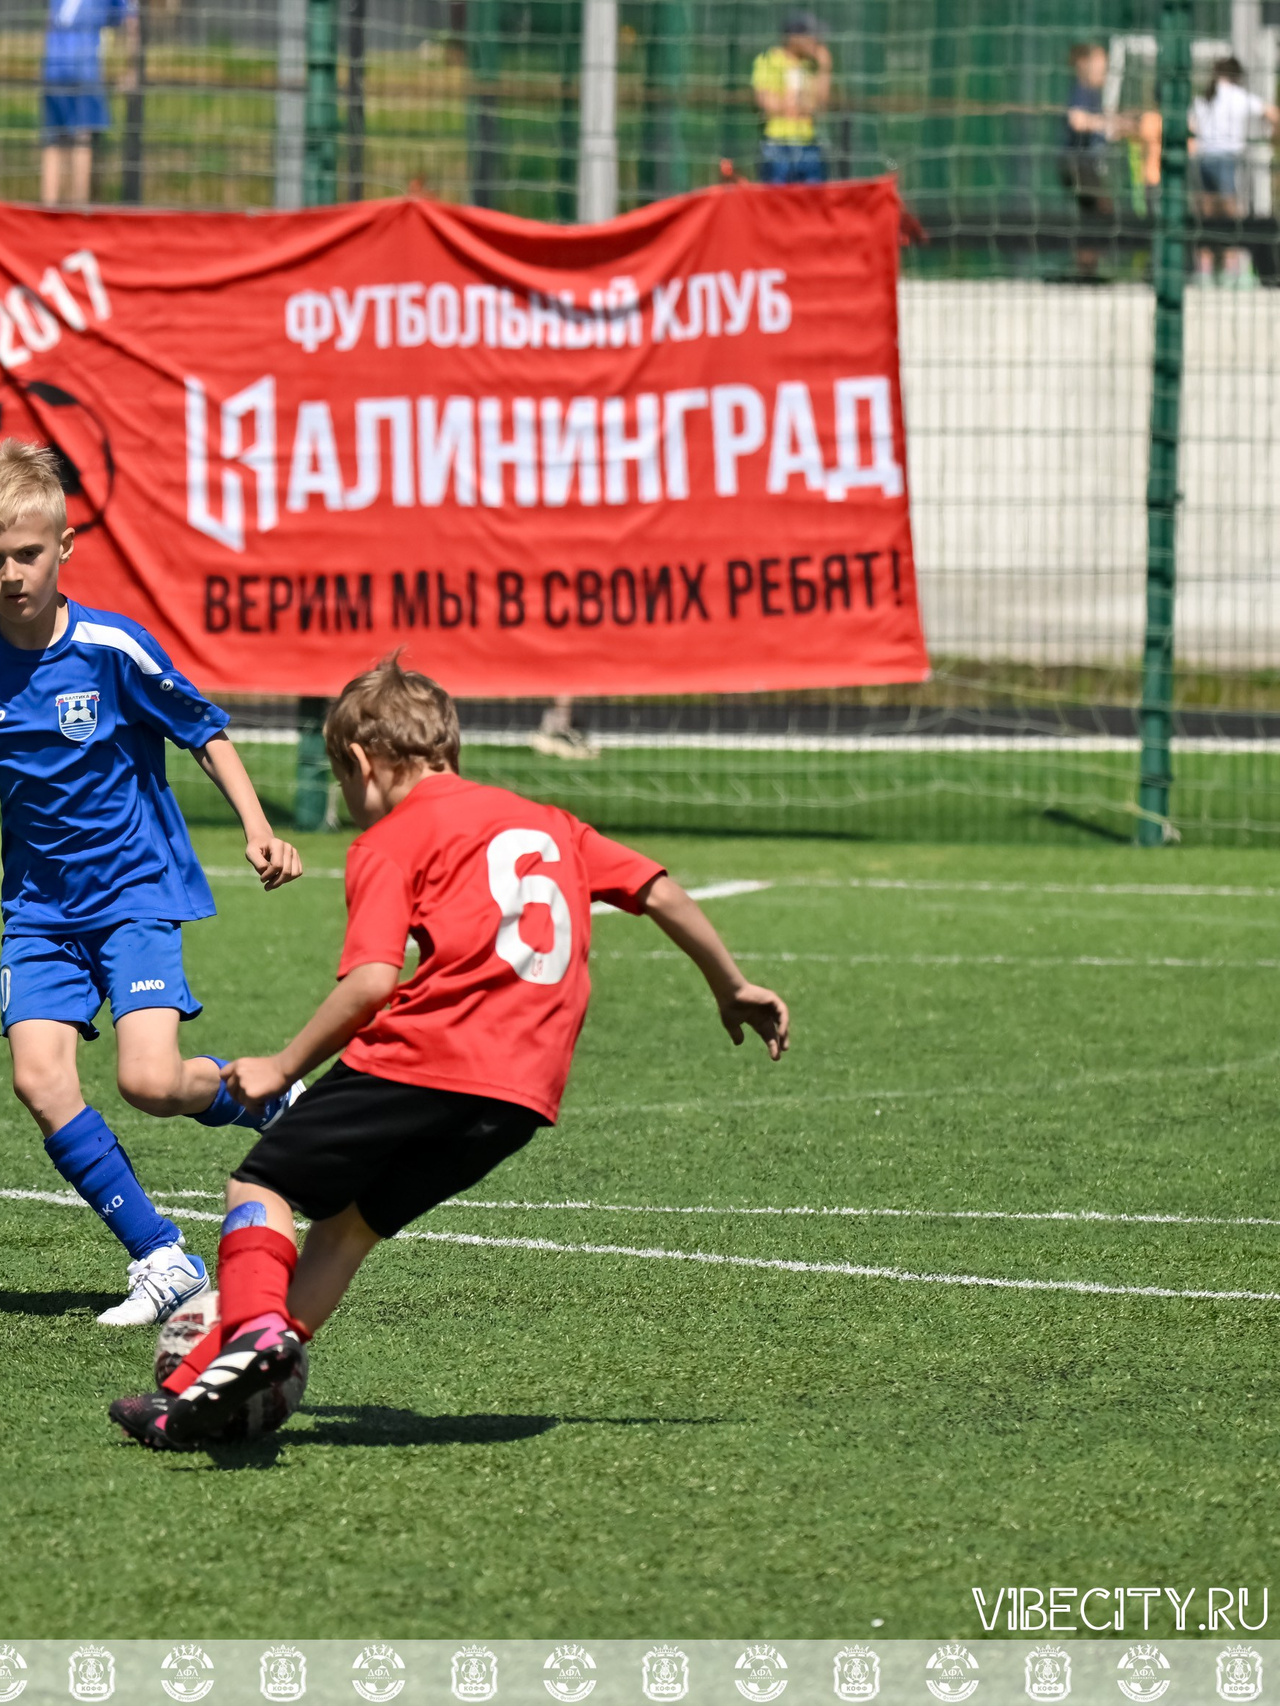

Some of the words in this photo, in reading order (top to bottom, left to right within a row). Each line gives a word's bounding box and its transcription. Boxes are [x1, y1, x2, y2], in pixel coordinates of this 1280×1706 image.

[284, 275, 642, 352] ФУТБОЛЬНЫЙ
[652, 269, 792, 342] КЛУБ
[205, 573, 374, 635] ВЕРИМ
[392, 570, 478, 630] МЫ
[497, 569, 526, 630] В
[543, 561, 710, 629] СВОИХ
[727, 547, 902, 619] РЕБЯТ!
[486, 827, 571, 985] 6
[129, 979, 166, 994] JAKO
